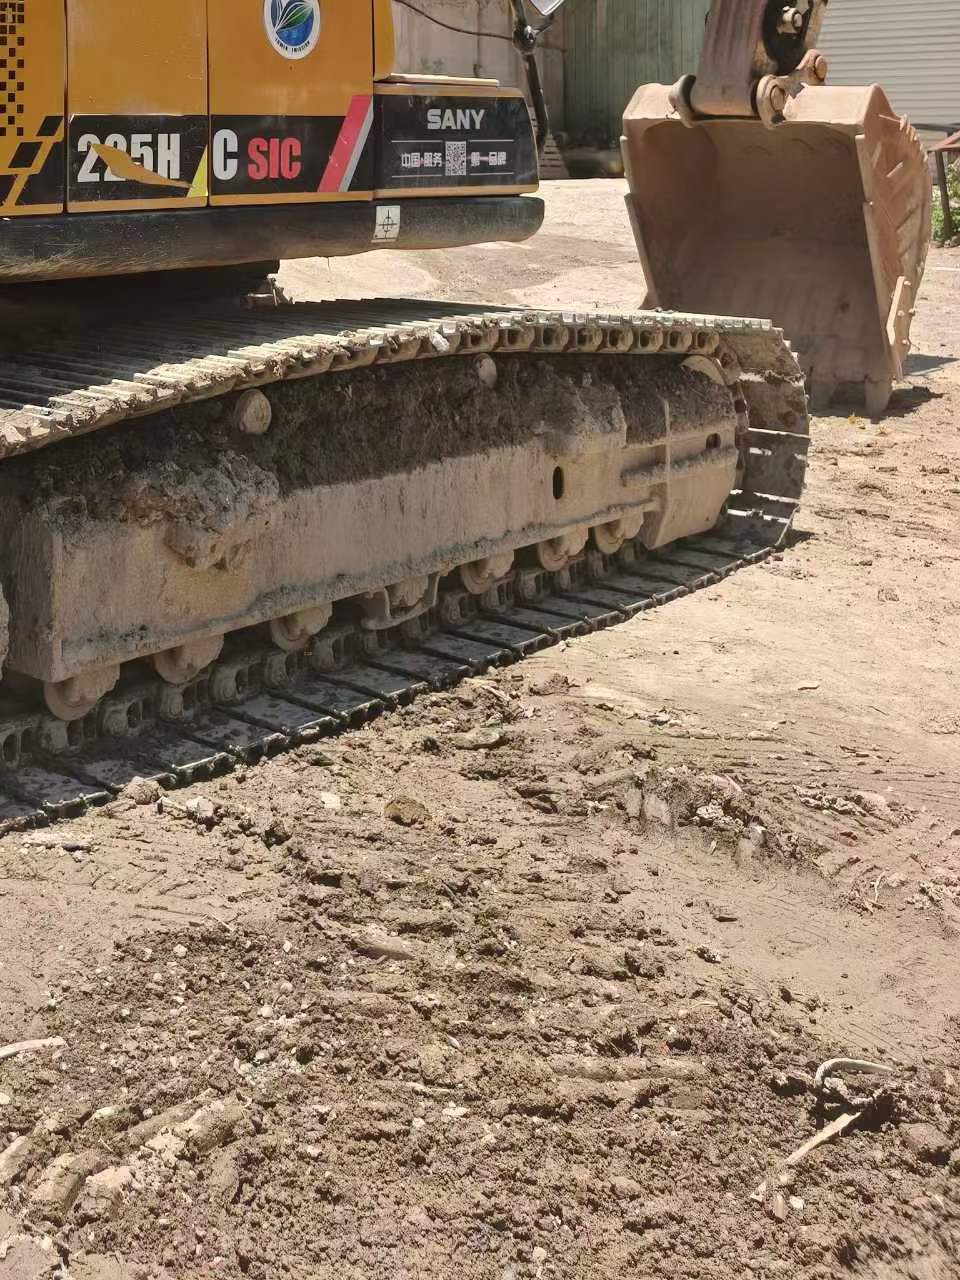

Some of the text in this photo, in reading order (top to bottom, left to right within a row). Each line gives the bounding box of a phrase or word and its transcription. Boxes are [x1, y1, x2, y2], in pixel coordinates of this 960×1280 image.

[426, 108, 486, 130] SANY
[212, 128, 239, 181] C
[247, 136, 302, 180] SIC
